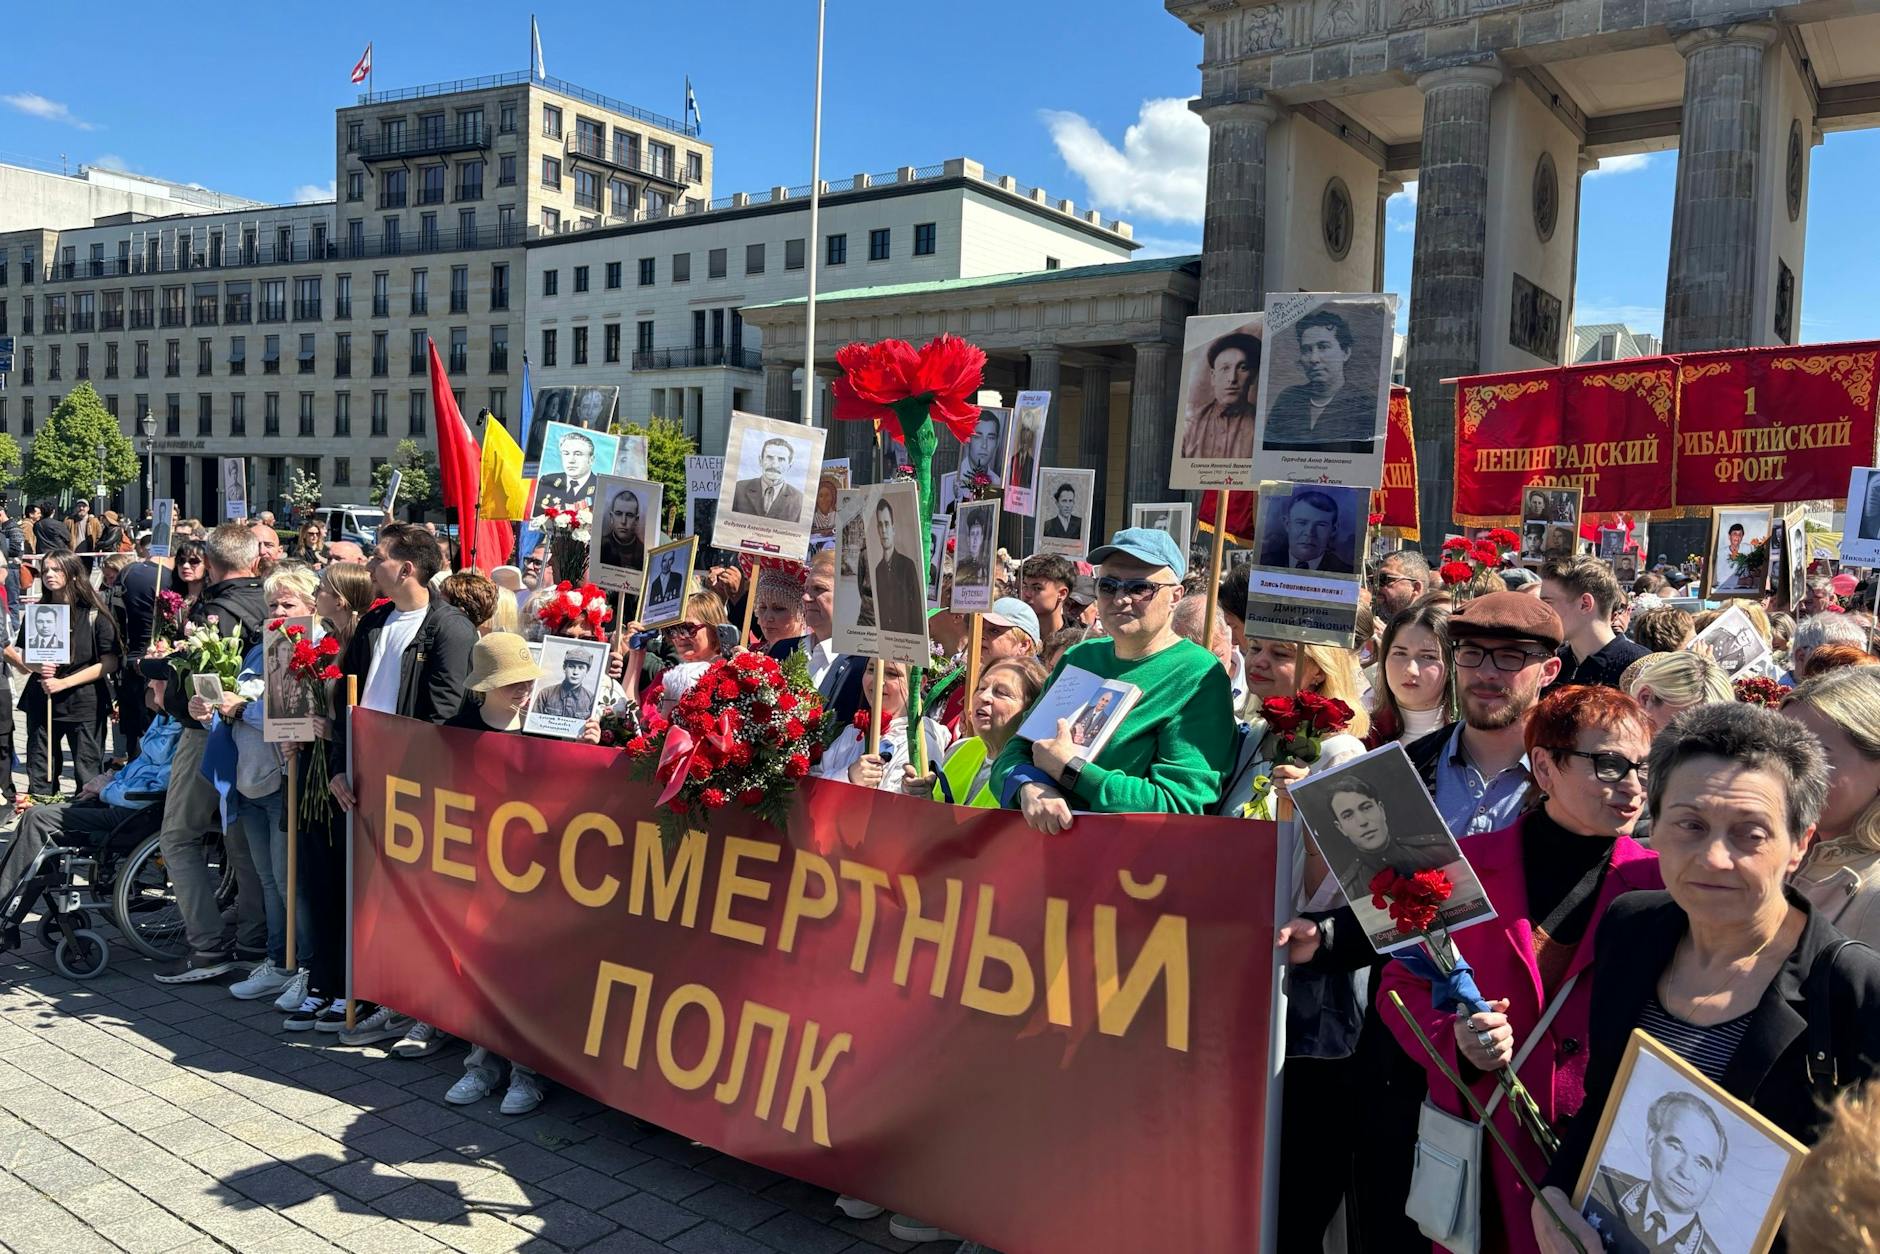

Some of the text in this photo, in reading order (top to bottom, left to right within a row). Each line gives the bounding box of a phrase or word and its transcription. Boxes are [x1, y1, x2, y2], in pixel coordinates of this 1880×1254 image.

[1743, 387, 1757, 415] 1
[689, 457, 723, 469] ГАЛЕН
[1474, 434, 1659, 472] ЛЕНИНГРАДСКИЙ
[1715, 456, 1787, 483] ФРОНТ
[691, 481, 721, 492] ВАСИ
[1273, 603, 1329, 616] Дмитриев
[384, 775, 1190, 1053] БЕССМЕРТНЫЙ
[584, 960, 854, 1148] ПОЛК
